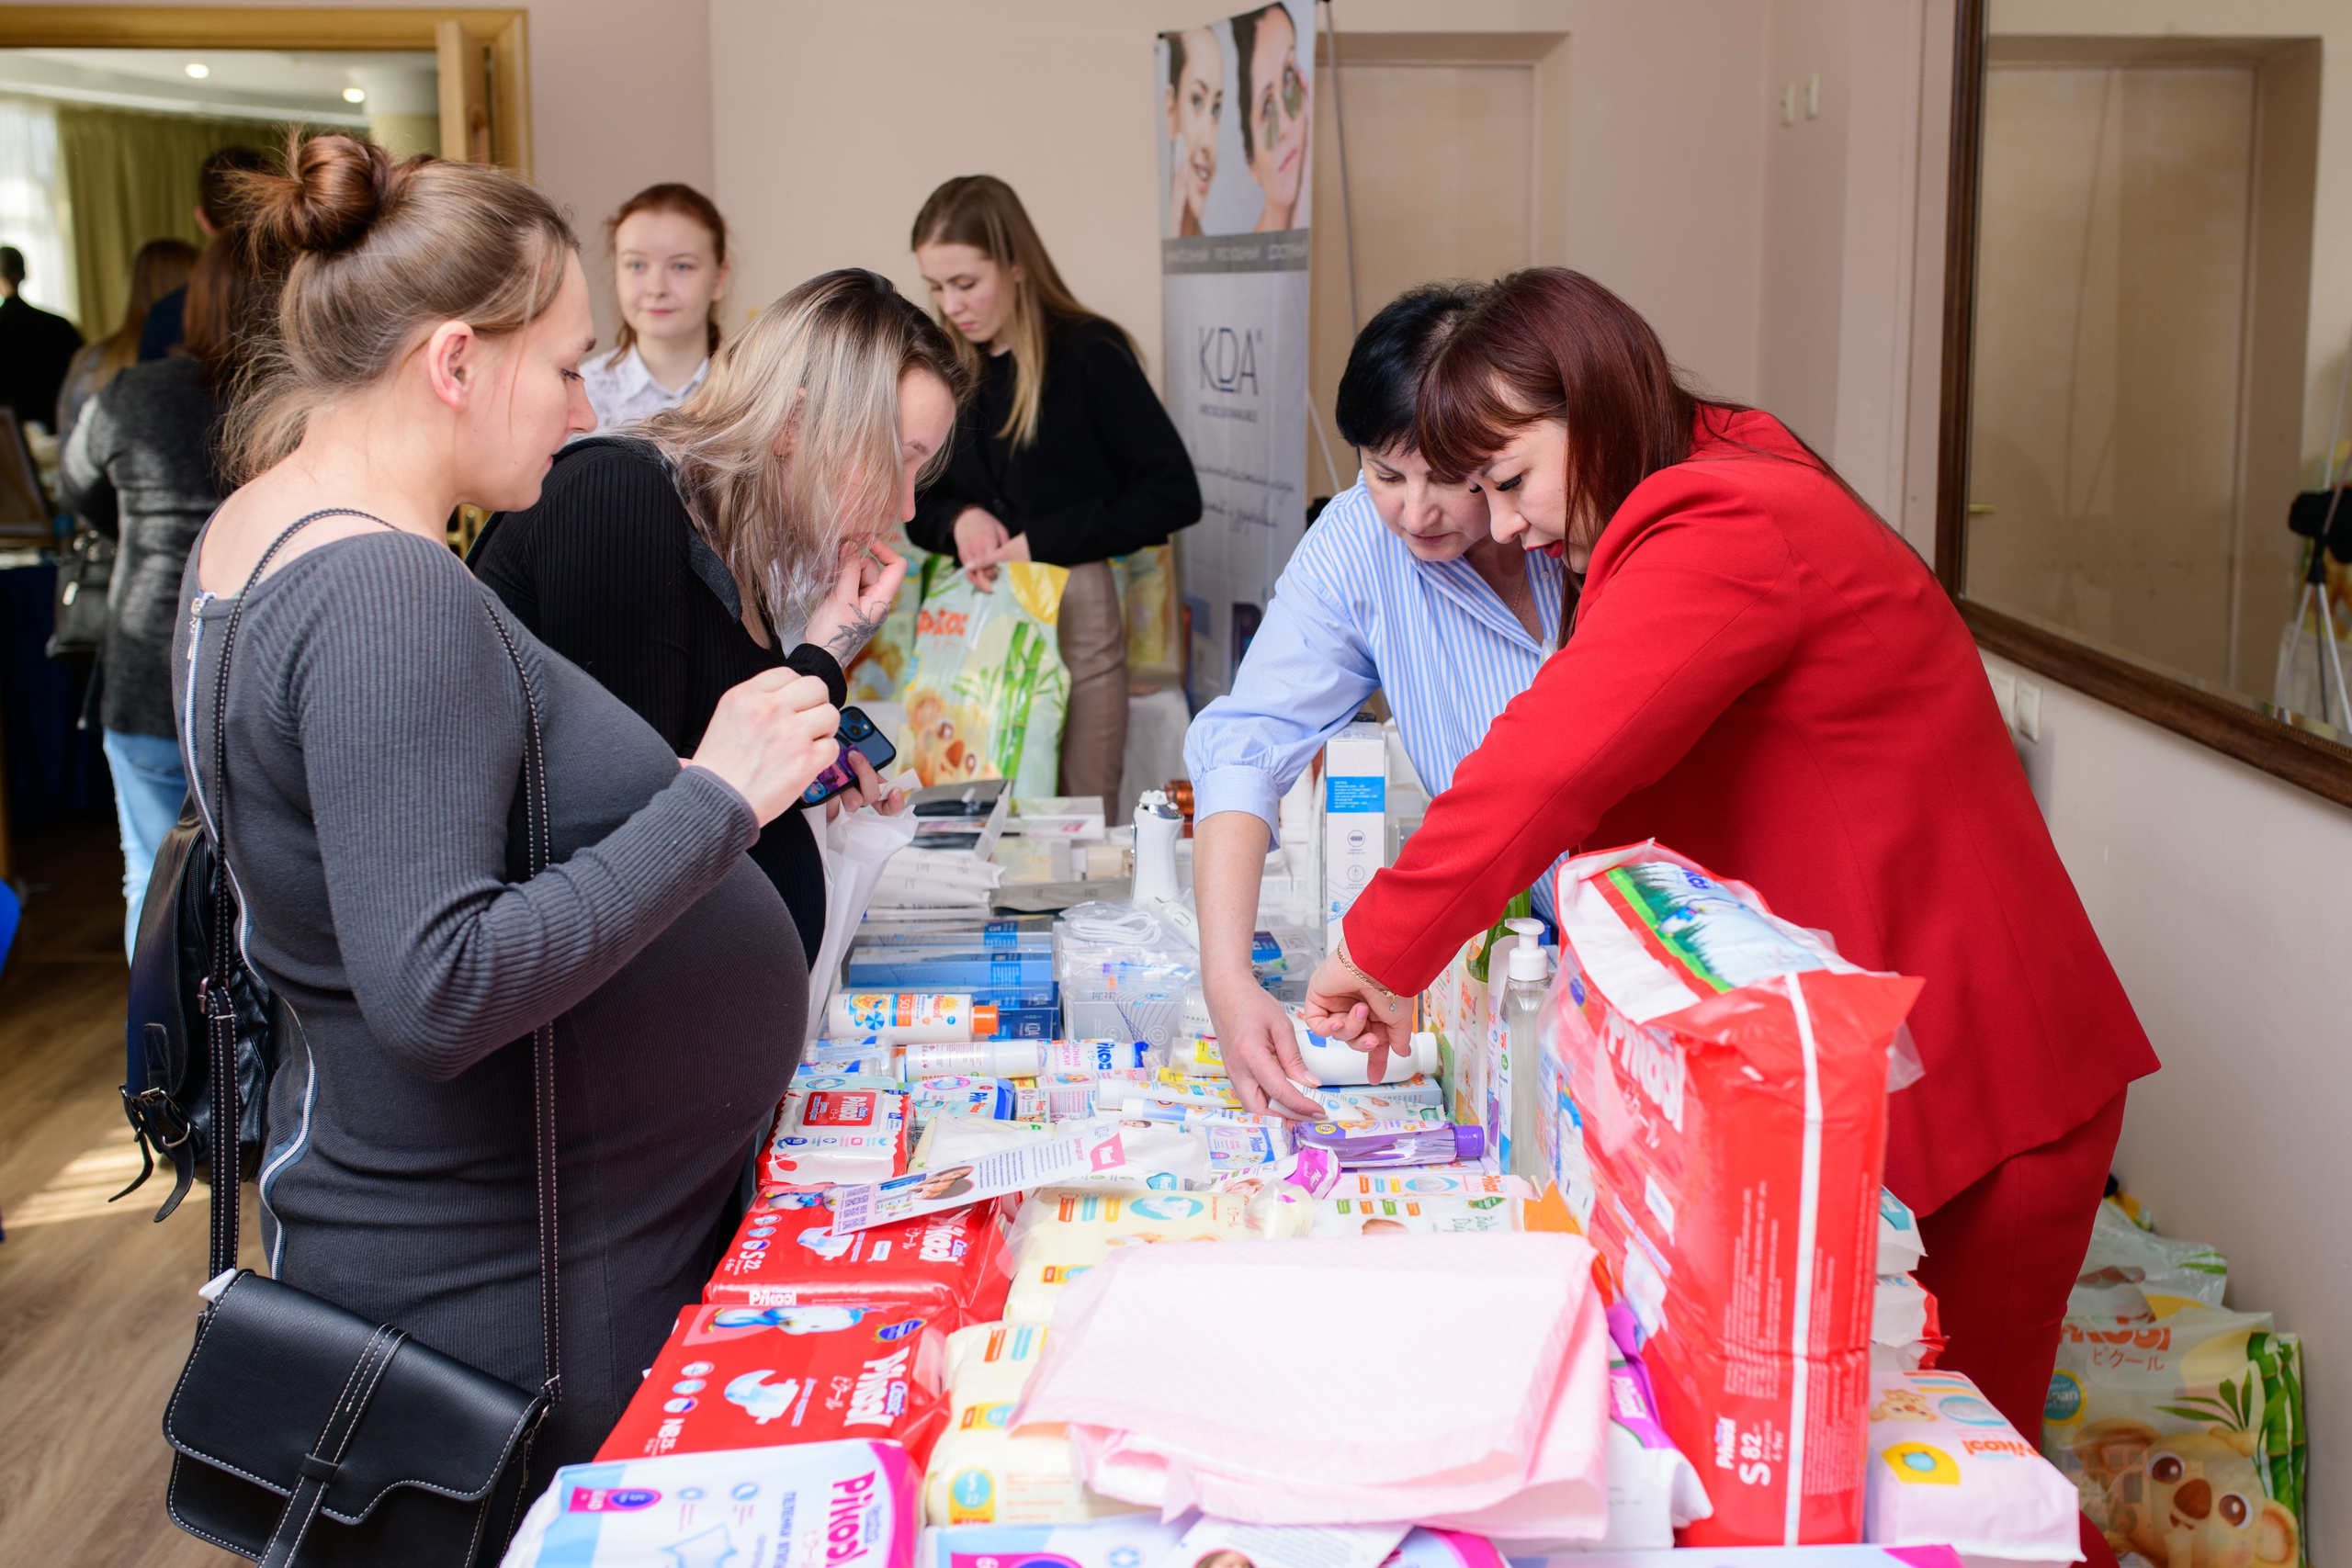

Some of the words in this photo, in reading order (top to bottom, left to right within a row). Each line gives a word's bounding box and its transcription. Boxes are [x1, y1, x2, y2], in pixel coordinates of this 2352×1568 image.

[1198, 327, 1260, 396] KDA
[839, 1096, 867, 1121] Pikool
[1249, 1137, 1265, 1152] Pikool
[749, 1290, 797, 1305] Pikool
[2093, 1346, 2165, 1372] ピクール
[843, 1346, 910, 1428] Pikool
[888, 1382, 909, 1417] Classic
[657, 1418, 685, 1438] NB
[1740, 1432, 1763, 1461] 82
[1738, 1461, 1772, 1486] S
